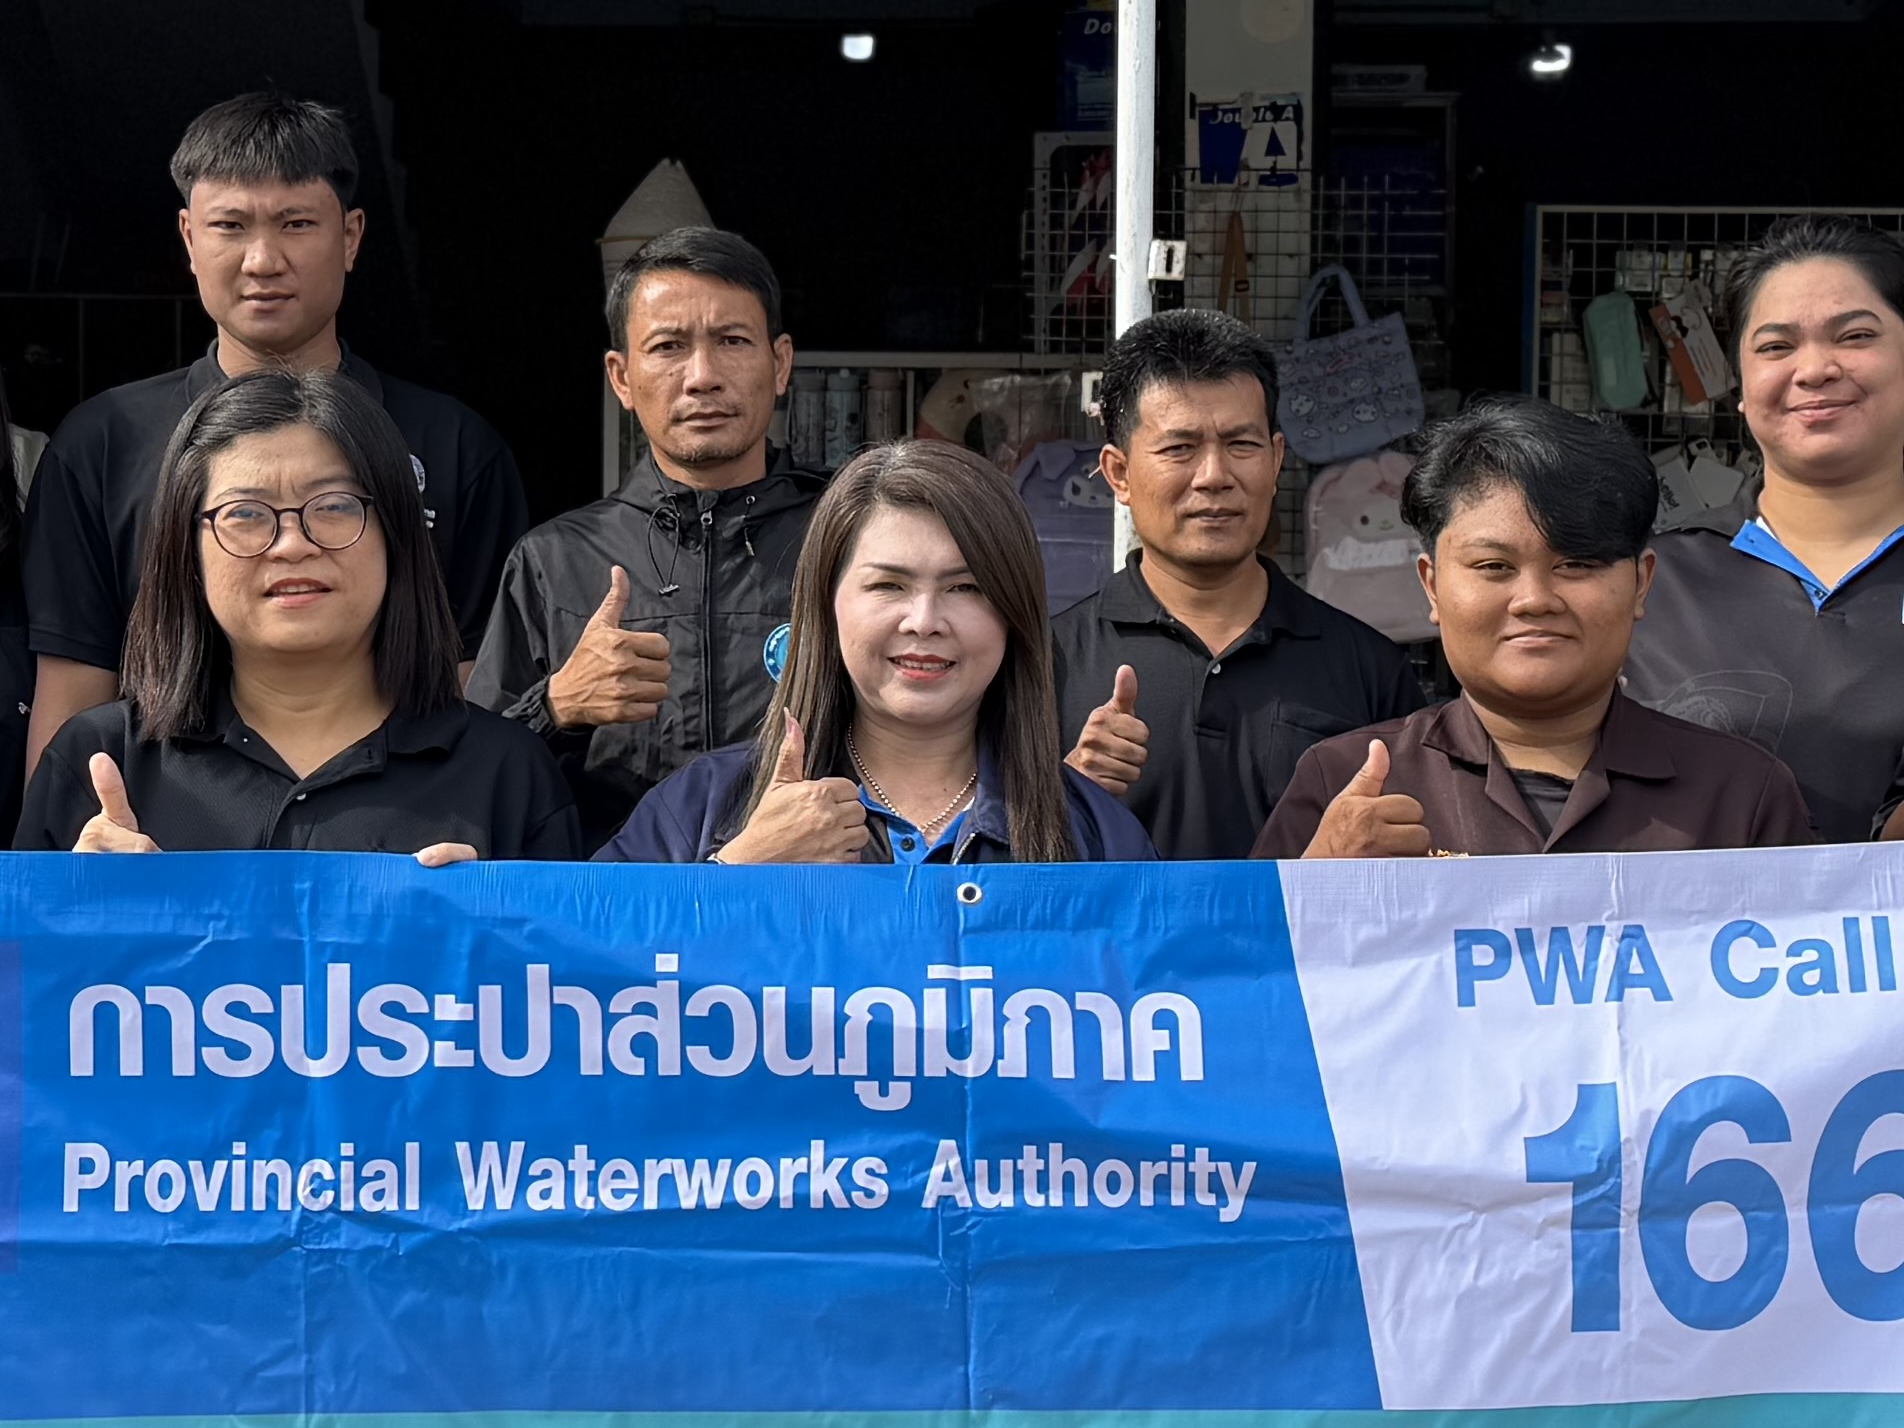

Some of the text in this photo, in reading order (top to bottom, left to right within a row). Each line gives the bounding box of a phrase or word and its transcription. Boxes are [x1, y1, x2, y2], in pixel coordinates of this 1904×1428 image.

[1454, 923, 1674, 1008] PWA
[1708, 915, 1897, 999] Call
[67, 952, 1205, 1112] การประปาส่วนภูมิภาค
[62, 1139, 1257, 1223] Provincial Waterworks Authority
